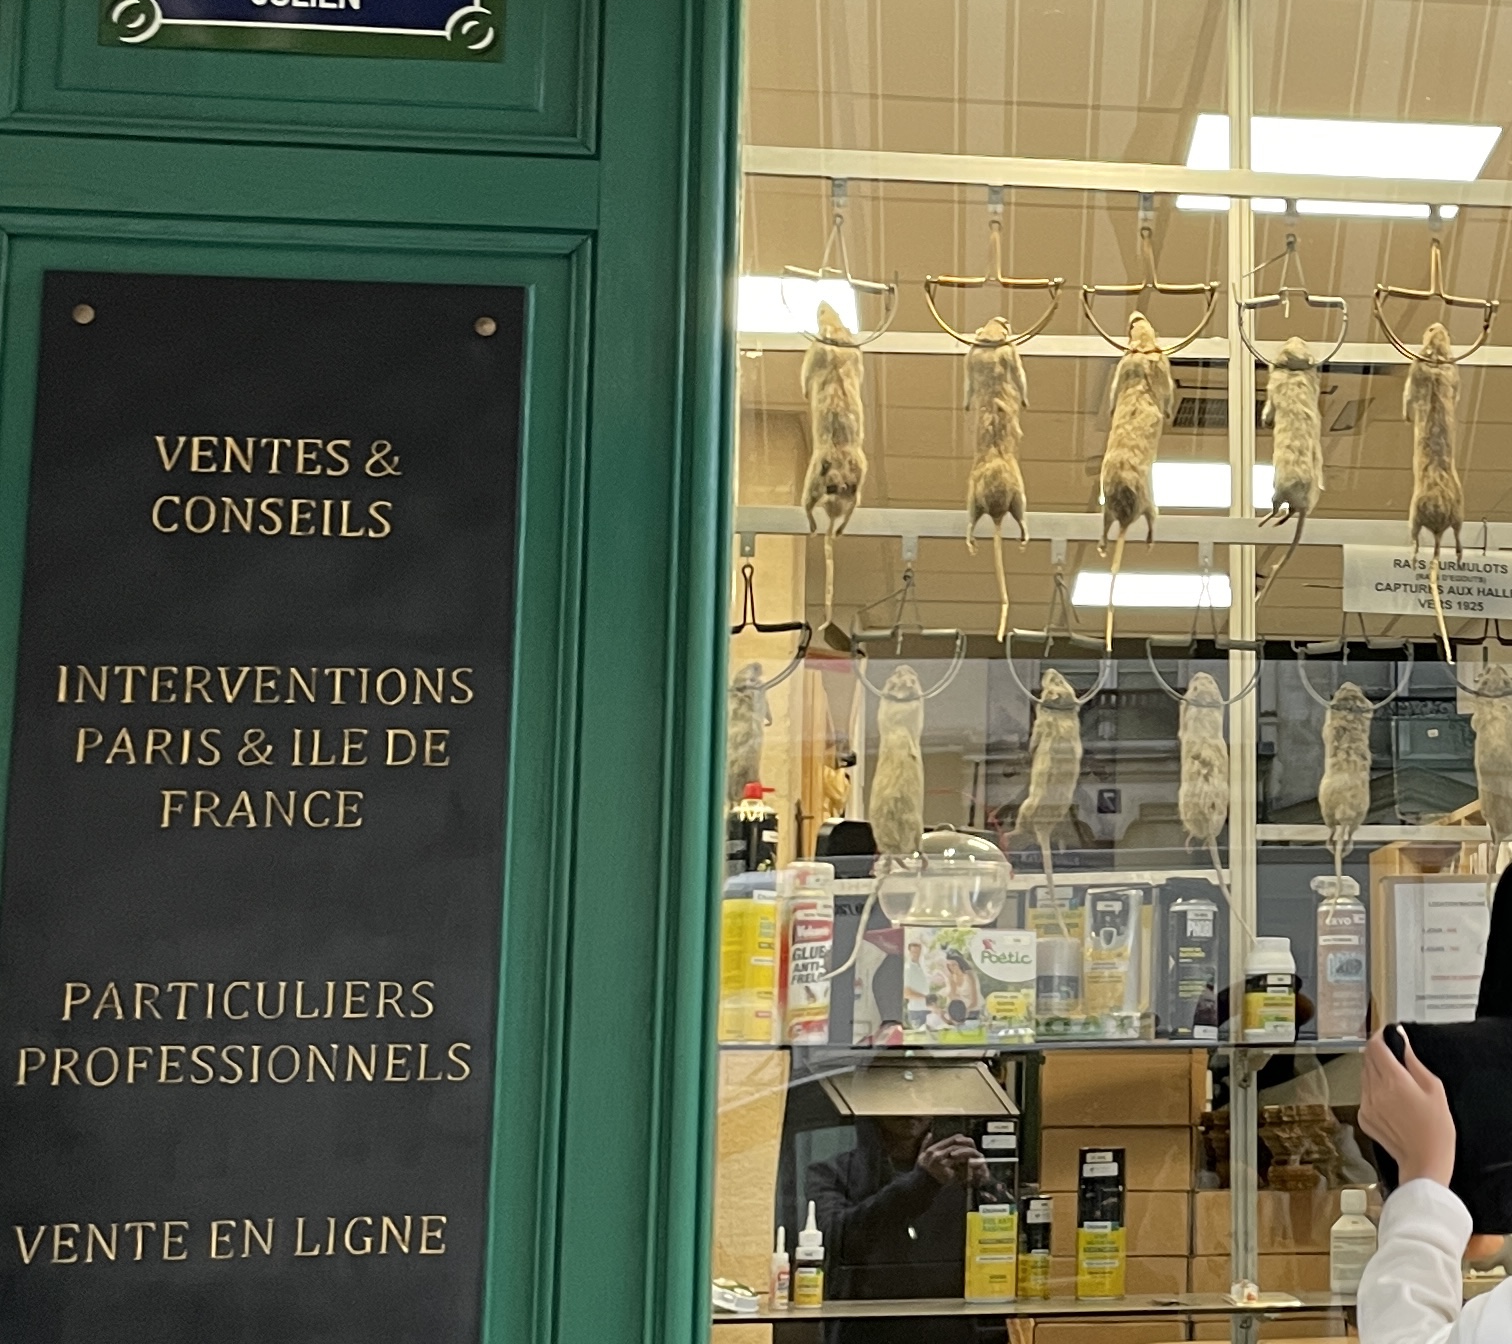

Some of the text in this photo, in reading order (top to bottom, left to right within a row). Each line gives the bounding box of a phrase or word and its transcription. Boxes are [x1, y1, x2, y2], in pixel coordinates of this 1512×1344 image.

[154, 434, 403, 477] VENTES &
[151, 495, 394, 539] CONSEILS
[1393, 558, 1509, 575] RAS URMULOTS
[1447, 585, 1474, 597] AUX
[56, 664, 476, 706] INTERVENTIONS
[75, 727, 452, 767] PARIS & ILE DE
[160, 789, 365, 829] FRANCE
[62, 979, 436, 1022] PARTICULIERS
[15, 1042, 472, 1087] PROFESSIONNELS
[13, 1214, 449, 1265] VENTE EN LIGNE
